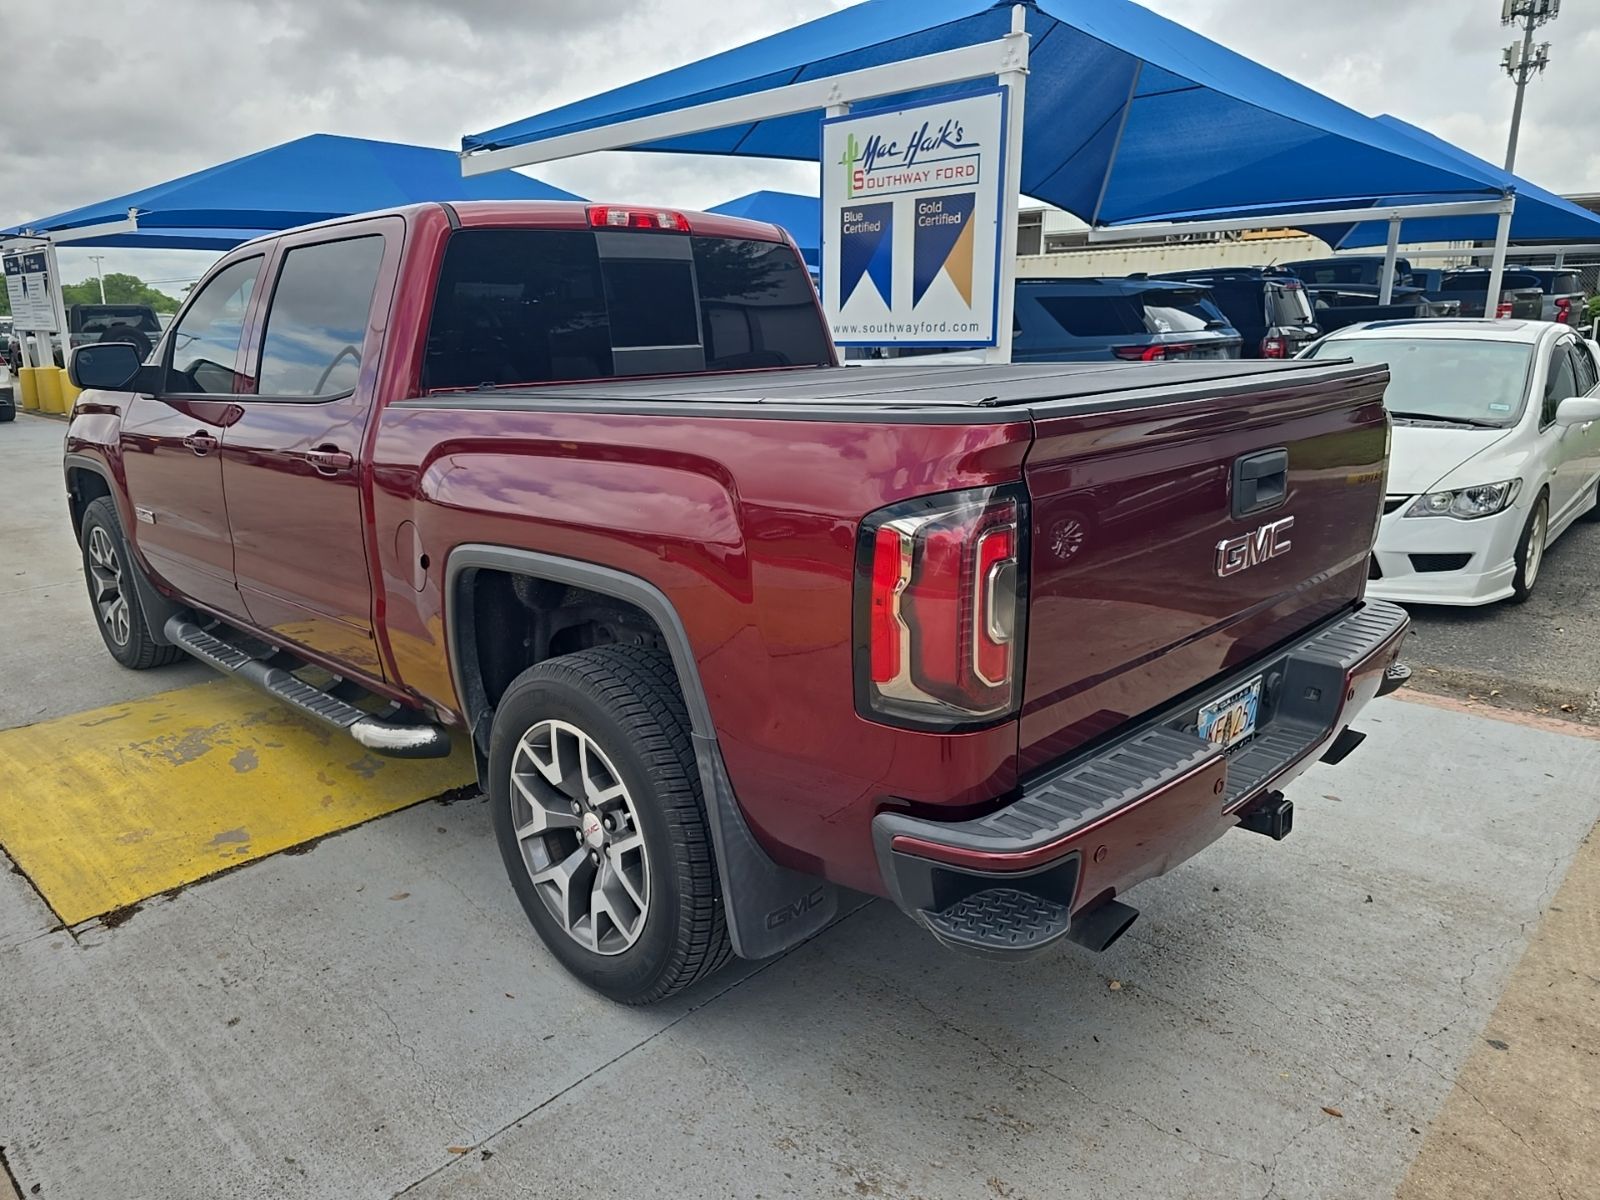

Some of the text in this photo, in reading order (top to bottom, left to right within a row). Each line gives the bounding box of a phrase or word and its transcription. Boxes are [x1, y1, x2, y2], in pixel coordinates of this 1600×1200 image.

[860, 119, 981, 175] Mac Haik's
[935, 165, 976, 181] FORD
[919, 201, 942, 214] Gold
[843, 212, 864, 222] Blue
[918, 212, 962, 226] Certified
[843, 221, 881, 234] Certified
[833, 321, 979, 335] www.southwayford.com
[1215, 515, 1295, 578] GMC
[765, 885, 824, 931] GMC
